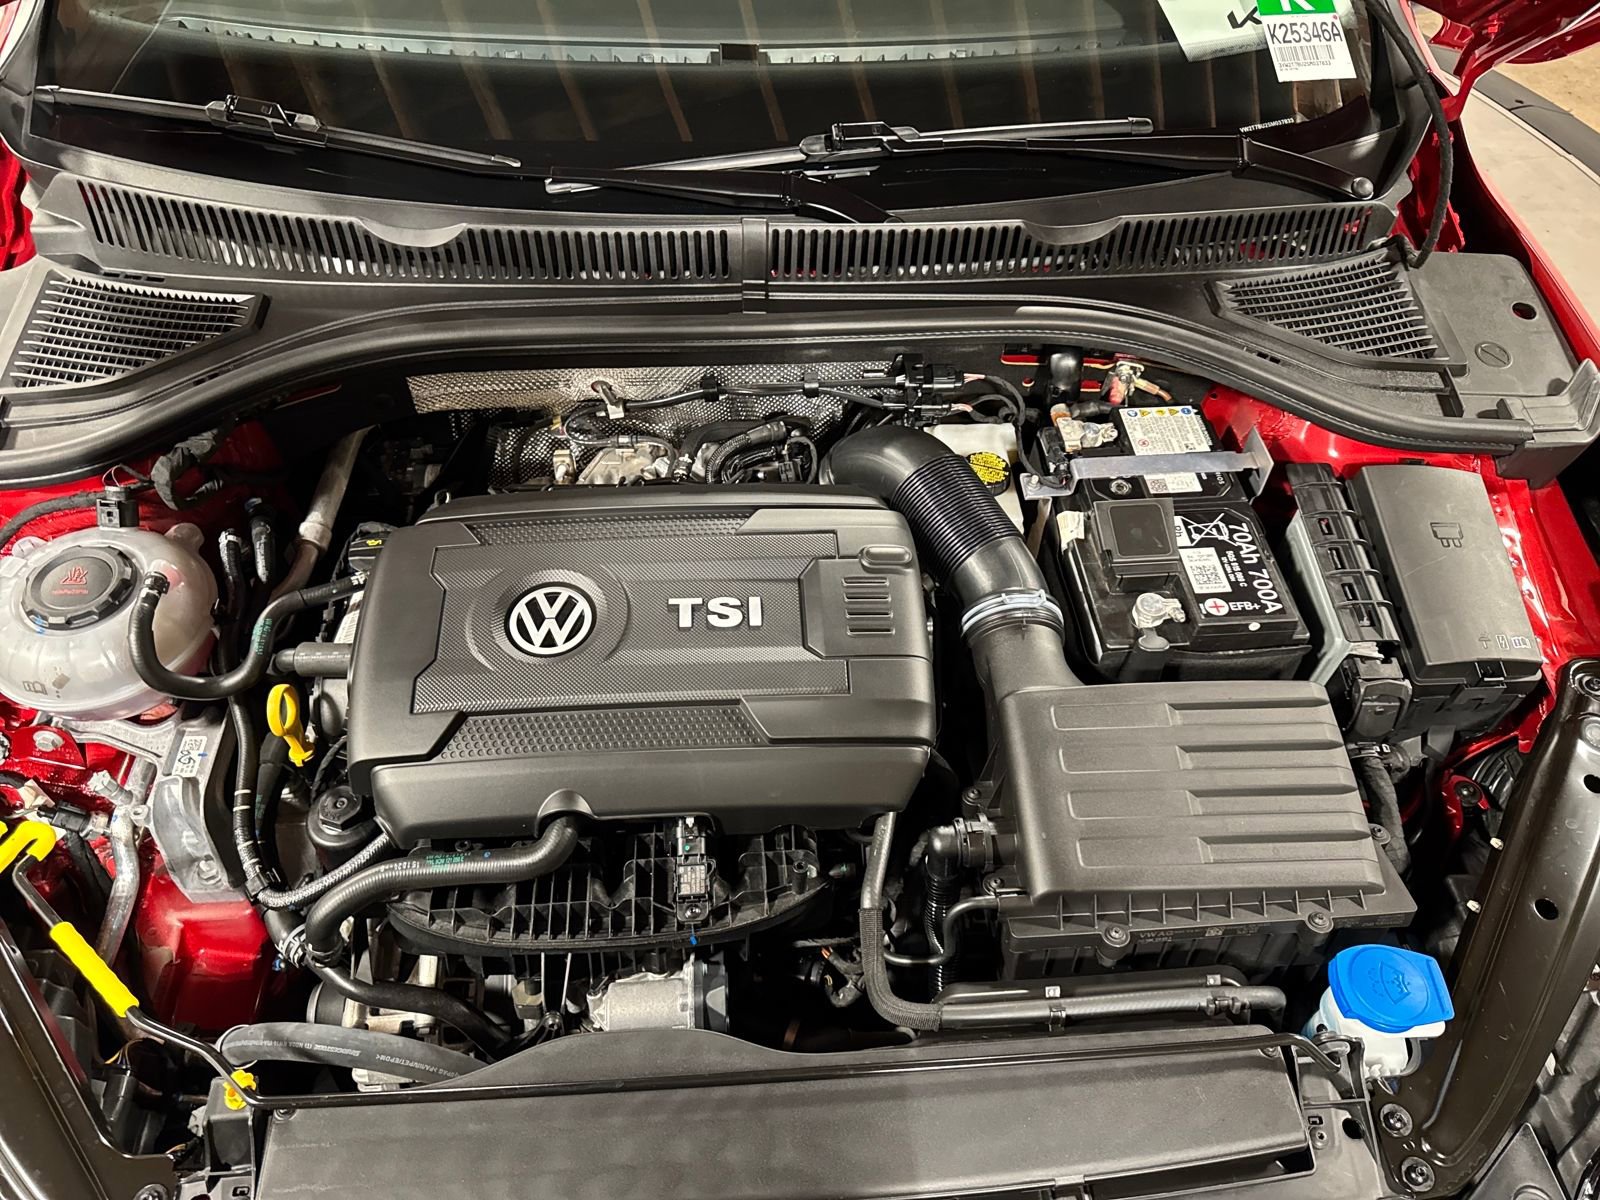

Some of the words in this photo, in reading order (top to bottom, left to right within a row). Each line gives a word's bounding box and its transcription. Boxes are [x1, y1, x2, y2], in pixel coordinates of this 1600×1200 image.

[1267, 21, 1343, 45] K25346A
[1228, 523, 1261, 564] 70Ah
[1248, 568, 1283, 614] 700A
[508, 585, 594, 656] VW
[667, 596, 763, 630] TSI
[1228, 601, 1261, 611] EFB+
